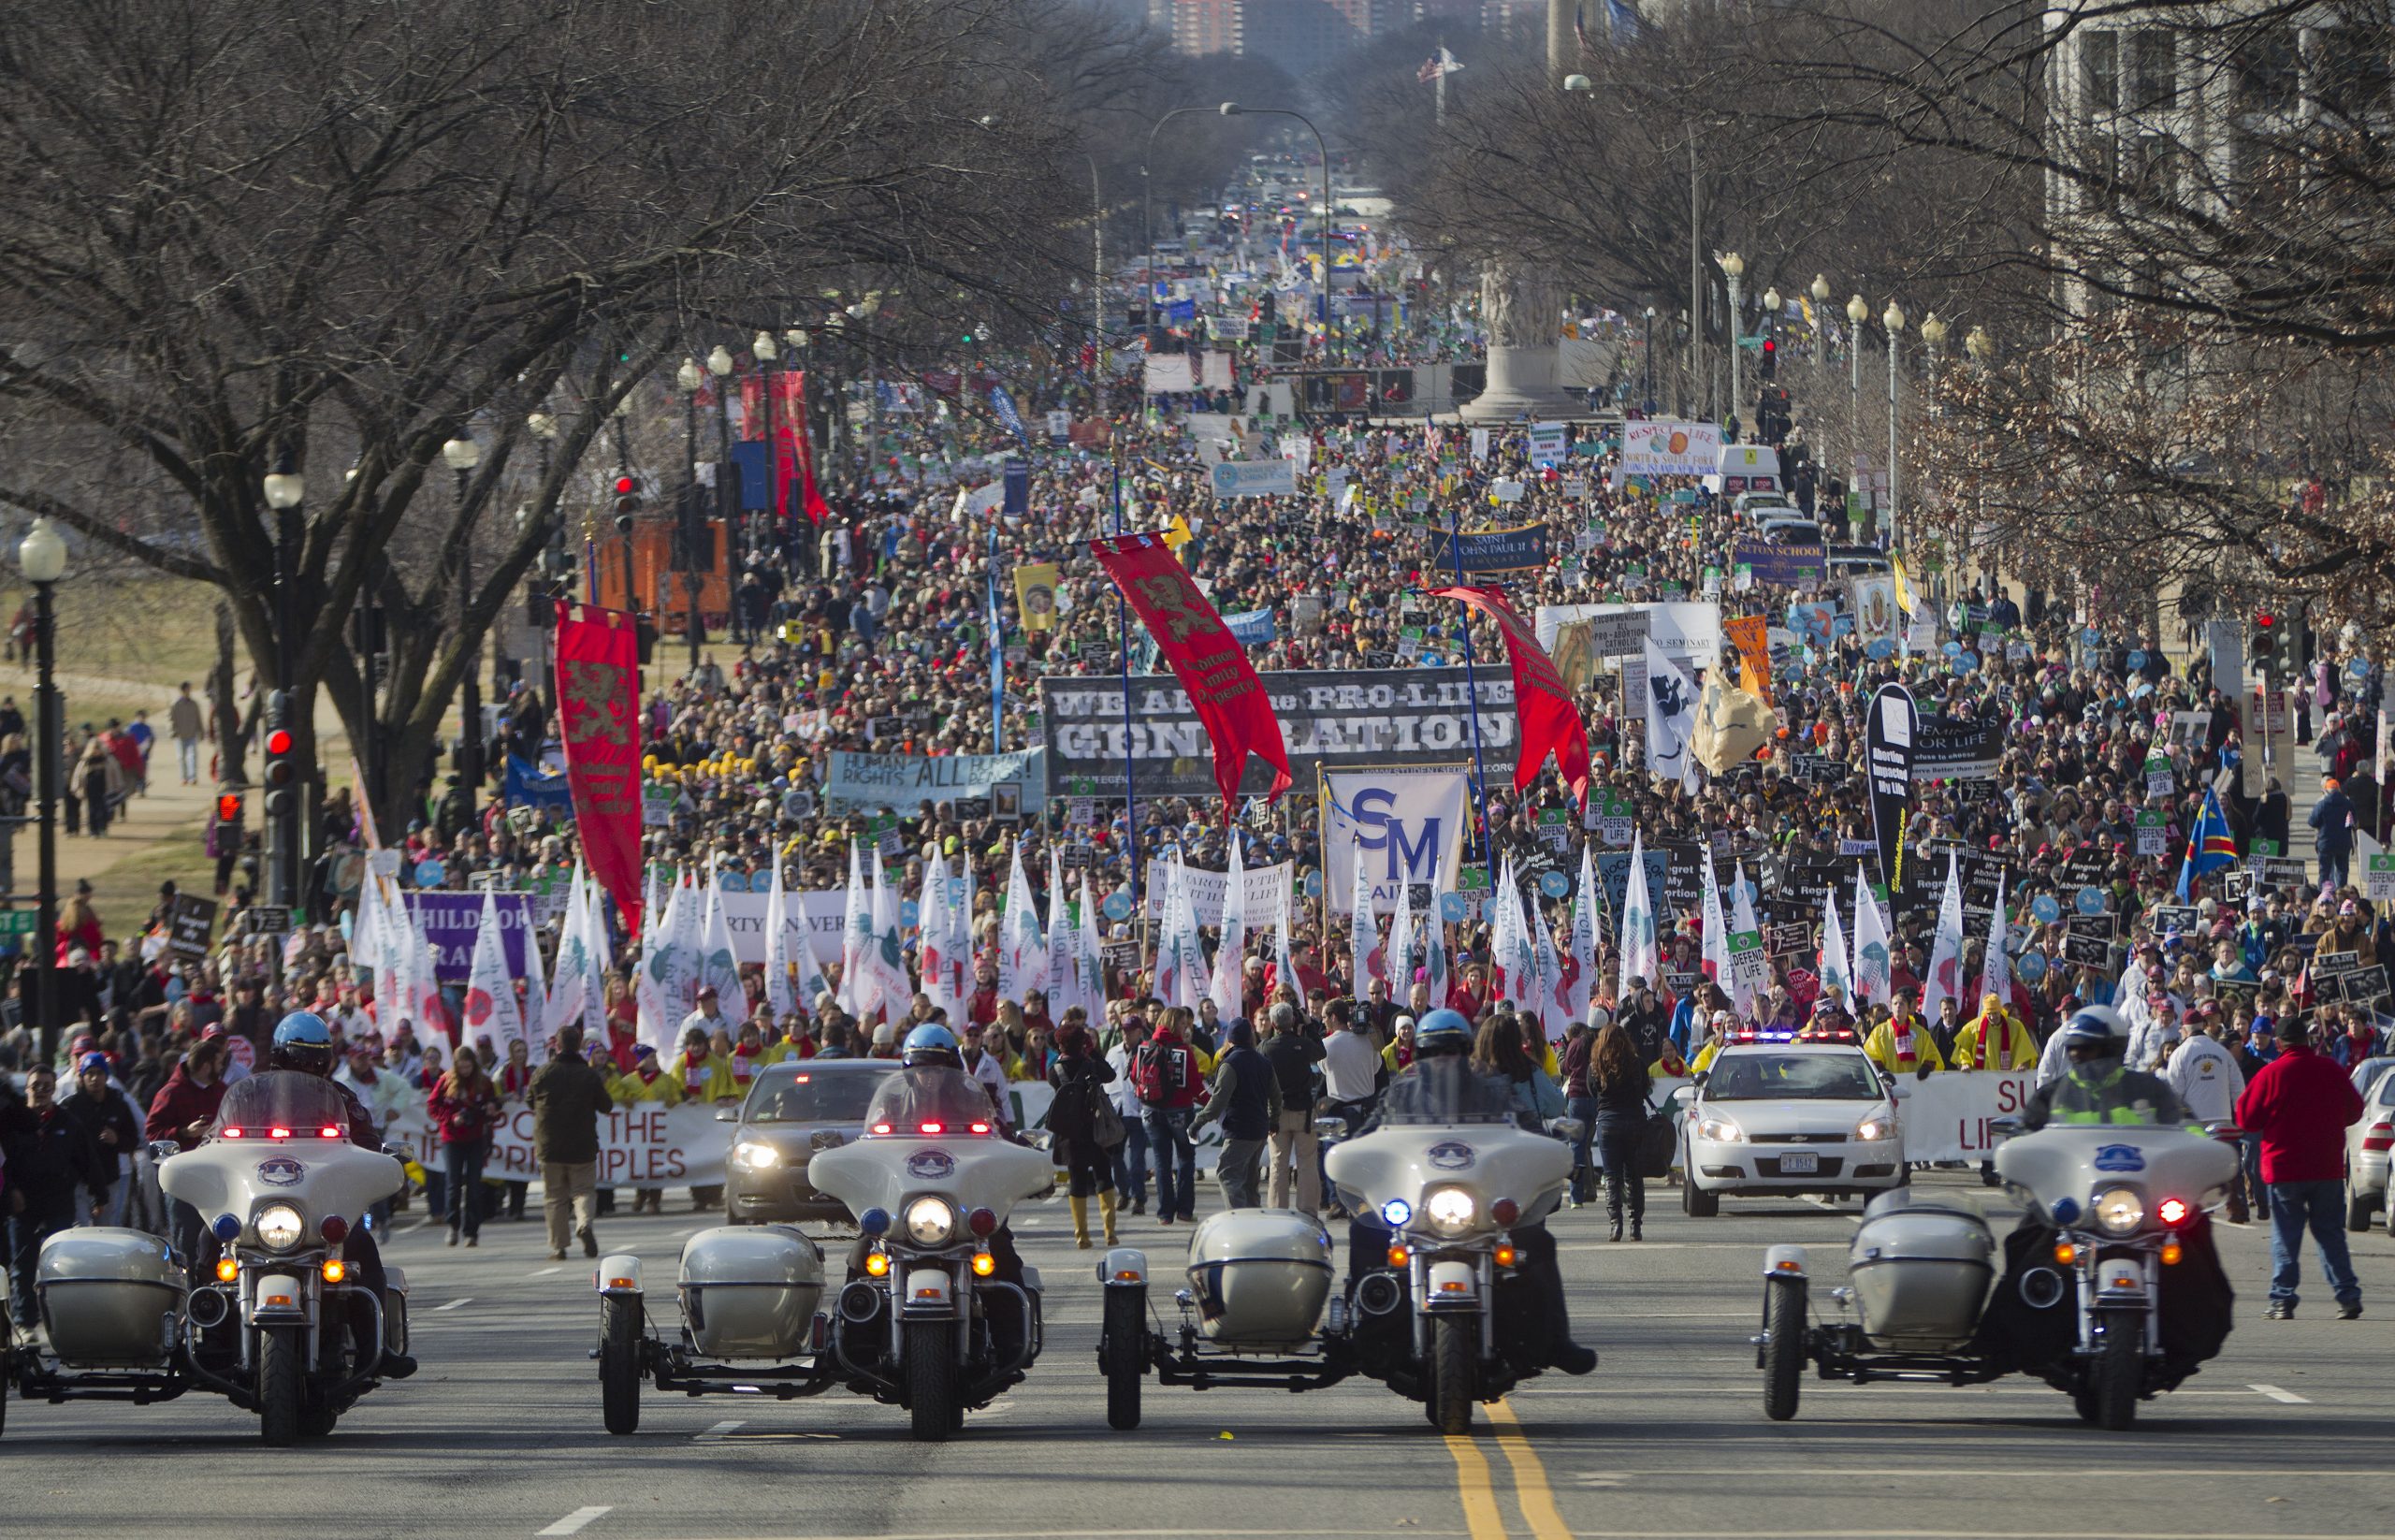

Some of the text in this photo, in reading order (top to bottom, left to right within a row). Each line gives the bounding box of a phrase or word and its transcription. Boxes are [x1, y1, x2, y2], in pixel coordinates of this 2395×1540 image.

[1688, 428, 1715, 444] LIFE
[1475, 535, 1506, 545] SAINT
[1738, 545, 1823, 558] SETON SCHOOL
[1594, 612, 1647, 625] EXCOMMUNICATE
[1617, 622, 1628, 631] ALL
[1604, 637, 1637, 648] CATHOLIC
[1666, 638, 1711, 648] SEMINARY
[1600, 646, 1643, 657] POLITICIANS
[1050, 690, 1126, 716] WE
[1307, 680, 1516, 710] PRO-LIFE
[1920, 732, 1987, 748] OR LIFE
[1873, 747, 1904, 765] Abortion
[843, 768, 905, 786] RIGHTS
[915, 758, 965, 788] ALL
[1872, 763, 1908, 782] Impacted
[2148, 772, 2171, 783] DEFEND
[1879, 779, 1906, 796] My Life
[2154, 782, 2168, 792] LIFE
[1589, 804, 1604, 814] DEF
[1604, 818, 1631, 828] DEFEND
[1540, 826, 1566, 836] DEFEND
[1610, 830, 1625, 840] LIFE
[2137, 828, 2165, 838] DEFEND
[2144, 840, 2159, 850] LIFE
[1527, 850, 1546, 864] Regret
[1982, 854, 2007, 864] Mourn
[2249, 855, 2264, 865] DEF
[1601, 859, 1651, 882] DIOCEE
[1985, 862, 1996, 871] My
[2070, 863, 2102, 873] Regret
[2266, 864, 2304, 875] #TEAMLIFE
[1973, 869, 2001, 879] Aborte
[2075, 872, 2089, 882] My
[2369, 874, 2395, 883] DEFEND
[1667, 876, 1682, 887] My
[1666, 888, 1698, 898] ortion
[2373, 884, 2388, 895] LIFE
[1928, 891, 1944, 901] My
[1811, 897, 1825, 908] My
[178, 916, 209, 929] Regret
[182, 929, 198, 940] My
[1733, 949, 1764, 966] DEFEND
[2332, 953, 2355, 964] AM
[1743, 964, 1762, 979] LIFE
[1788, 972, 1807, 984] STOP
[608, 1111, 667, 1144] THE
